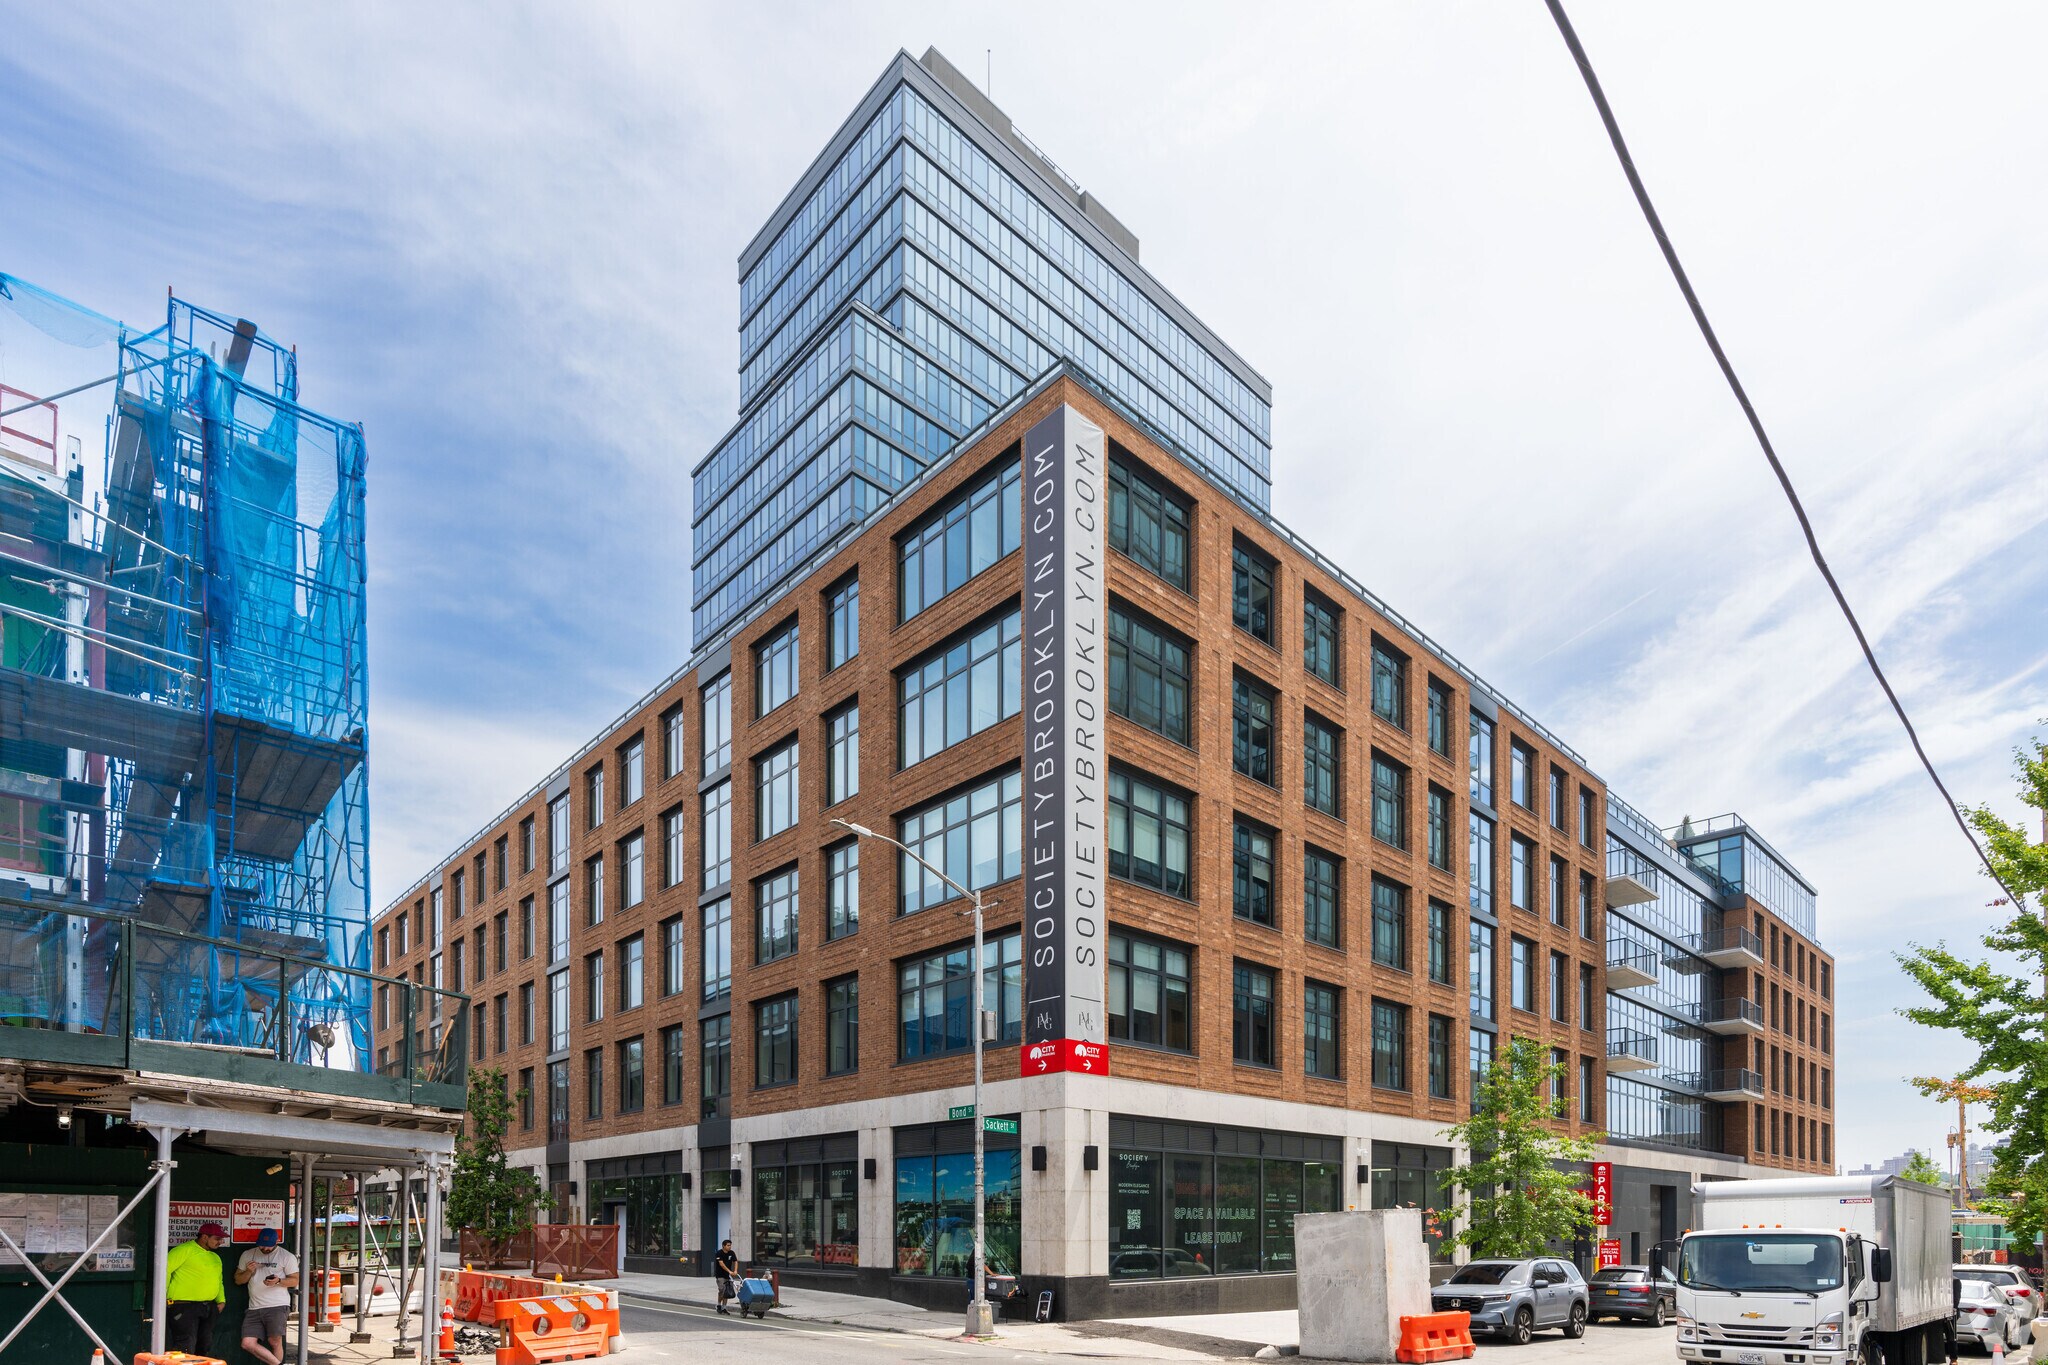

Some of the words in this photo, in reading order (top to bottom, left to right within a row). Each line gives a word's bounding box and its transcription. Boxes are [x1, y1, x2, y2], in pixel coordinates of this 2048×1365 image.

[1034, 443, 1054, 968] SOCIETYBROOKLYN.COM
[1075, 443, 1095, 967] SOCIETYBROOKLYN.COM
[1042, 1045, 1056, 1053] CITY
[952, 1107, 966, 1118] Bond
[986, 1120, 1009, 1131] Sackett
[1119, 1153, 1149, 1161] SOCIETY
[758, 1171, 782, 1179] SOCIETY
[177, 1205, 227, 1216] WARNING
[235, 1203, 250, 1213] NO
[1174, 1207, 1204, 1220] SPACE
[1206, 1207, 1256, 1220] AVAILABLE
[1184, 1232, 1213, 1244] LEASE
[1215, 1231, 1243, 1243] TODAY
[1603, 1255, 1613, 1264] 11
